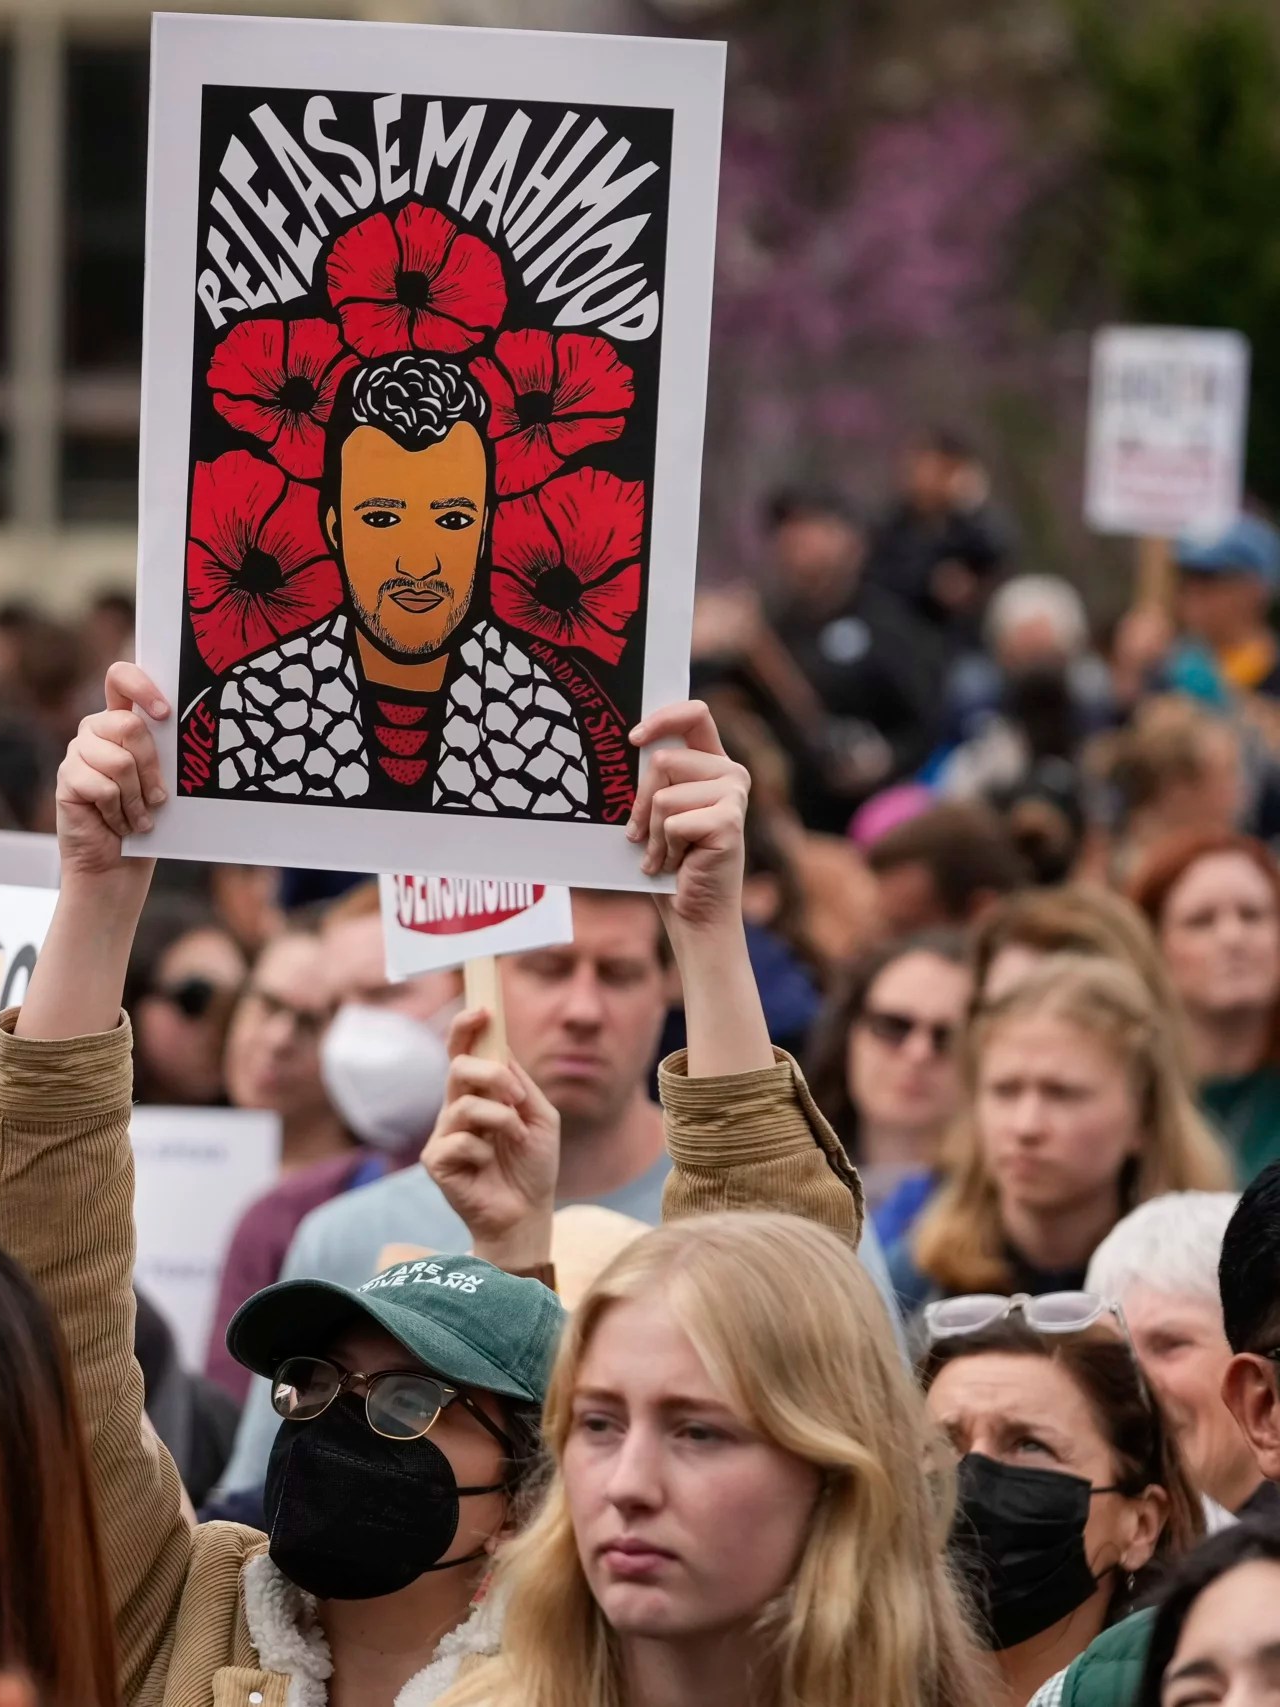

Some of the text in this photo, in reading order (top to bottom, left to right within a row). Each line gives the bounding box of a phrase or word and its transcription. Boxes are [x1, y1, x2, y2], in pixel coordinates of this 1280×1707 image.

[197, 93, 660, 341] RELEASE MAHMOUD
[583, 710, 637, 822] STUDENTS
[391, 1261, 444, 1277] ARE
[446, 1272, 485, 1286] ON
[411, 1272, 477, 1294] LAND
